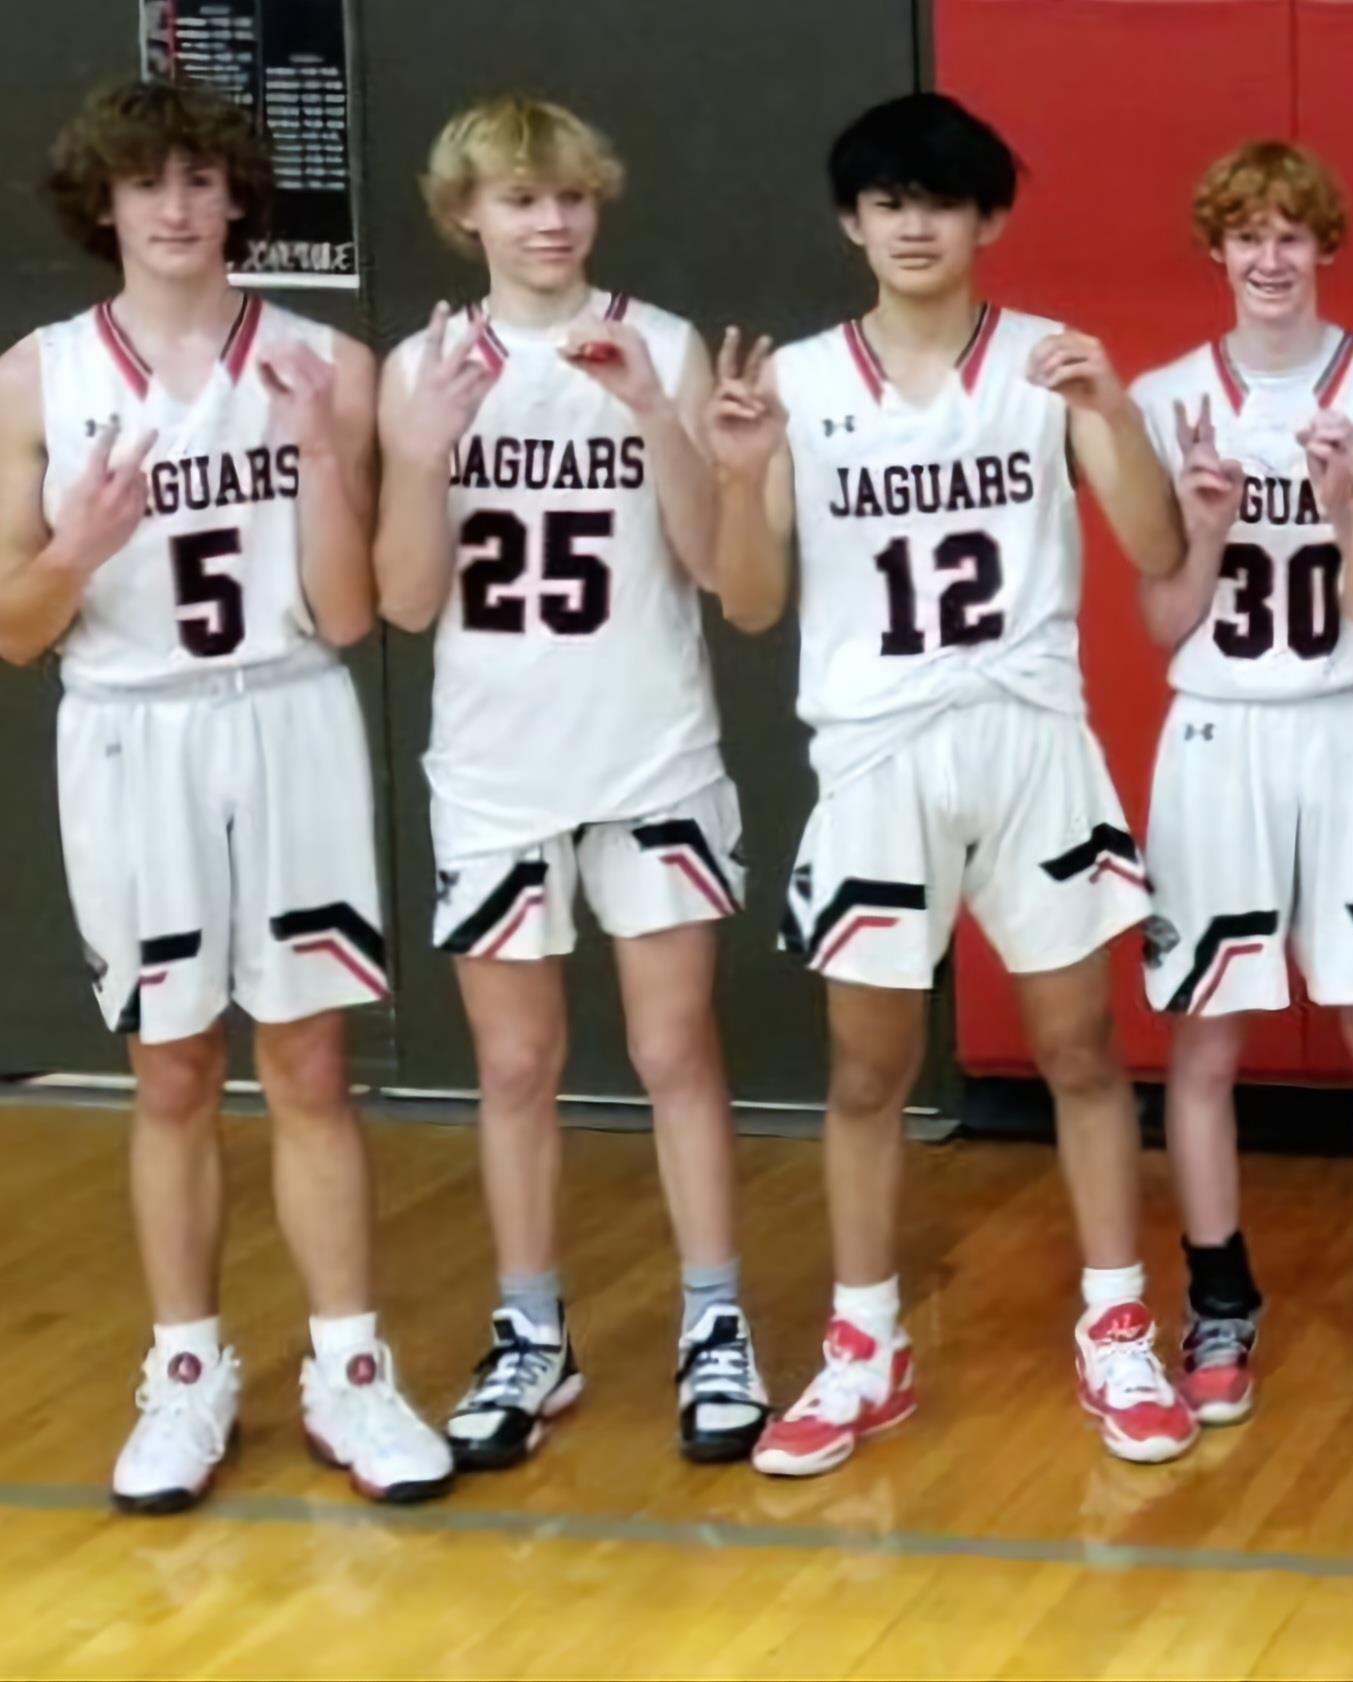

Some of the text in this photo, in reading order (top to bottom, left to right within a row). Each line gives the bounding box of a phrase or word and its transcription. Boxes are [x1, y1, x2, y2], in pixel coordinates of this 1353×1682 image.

[144, 444, 300, 517] GUARS
[829, 451, 1034, 518] JAGUARS
[168, 526, 246, 658] 5
[459, 508, 614, 635] 25
[872, 528, 1005, 656] 12
[1212, 541, 1342, 662] 30
